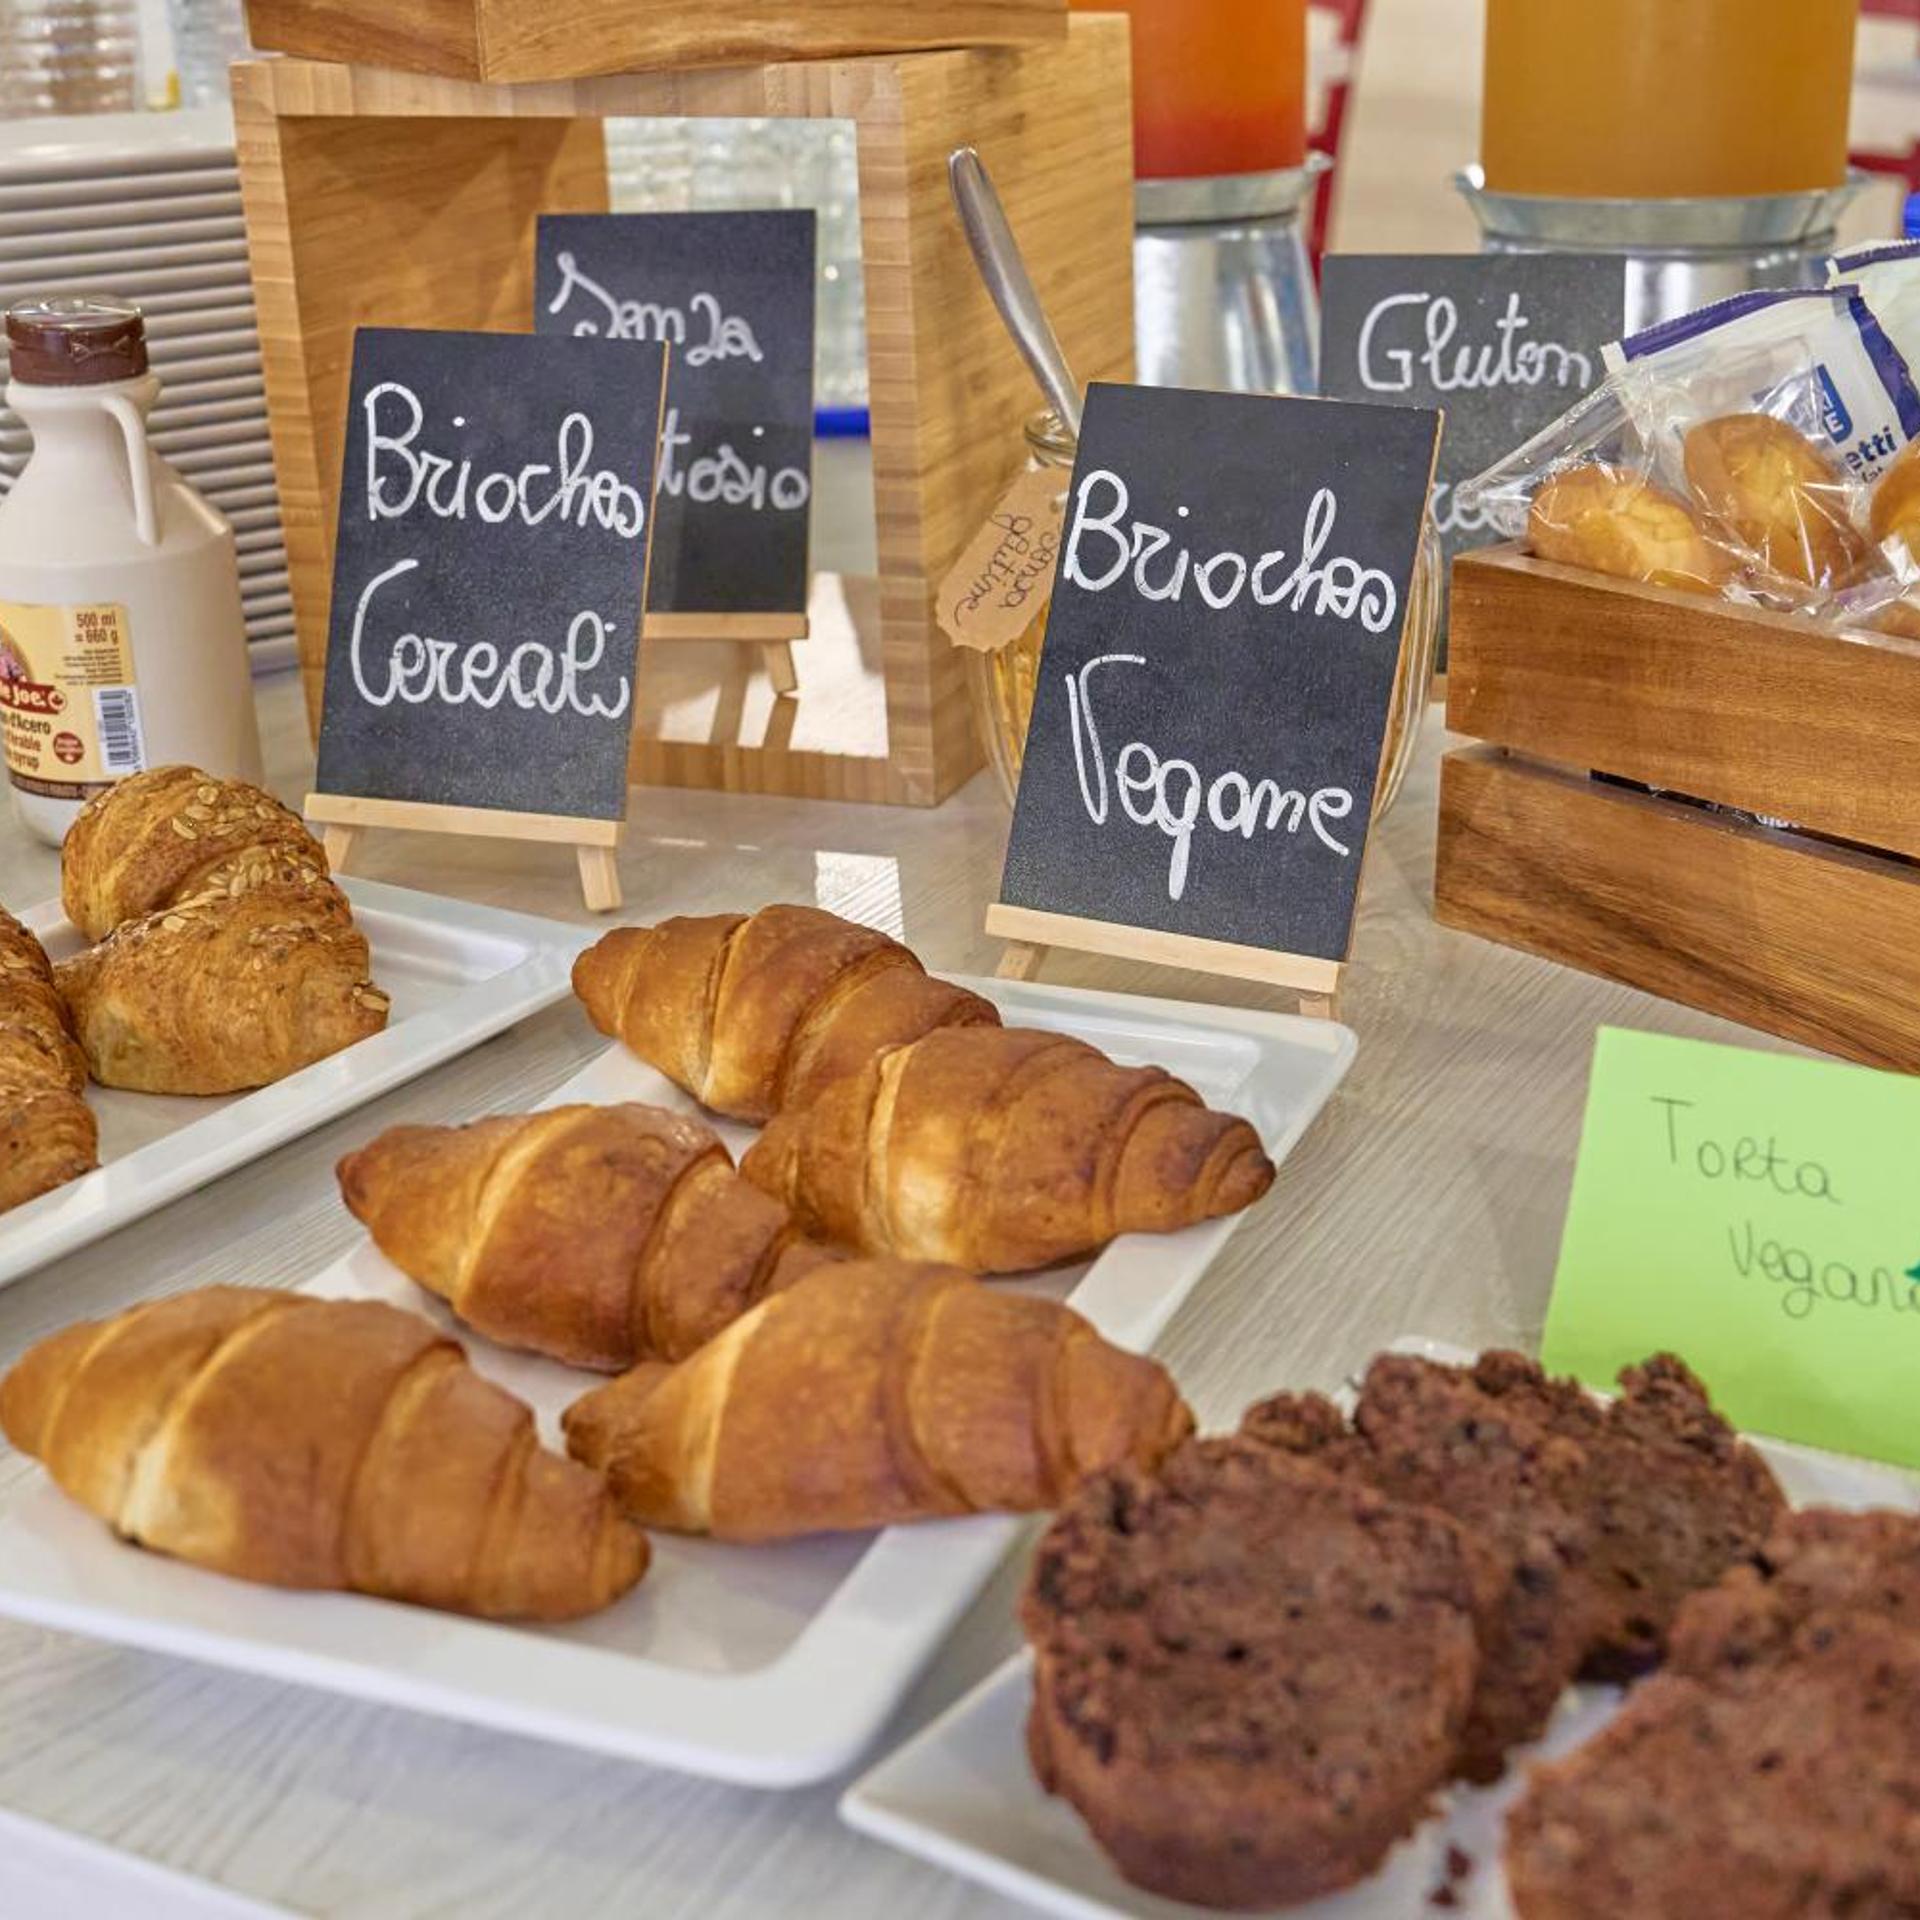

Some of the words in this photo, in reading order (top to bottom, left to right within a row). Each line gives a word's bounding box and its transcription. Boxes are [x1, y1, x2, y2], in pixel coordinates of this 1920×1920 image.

[363, 381, 646, 539] Brioches
[657, 407, 810, 511] tosio
[76, 613, 98, 628] 500
[101, 610, 116, 626] ml
[1063, 468, 1398, 634] Brioches
[350, 558, 632, 720] Cereali
[1065, 653, 1354, 900] Vegane
